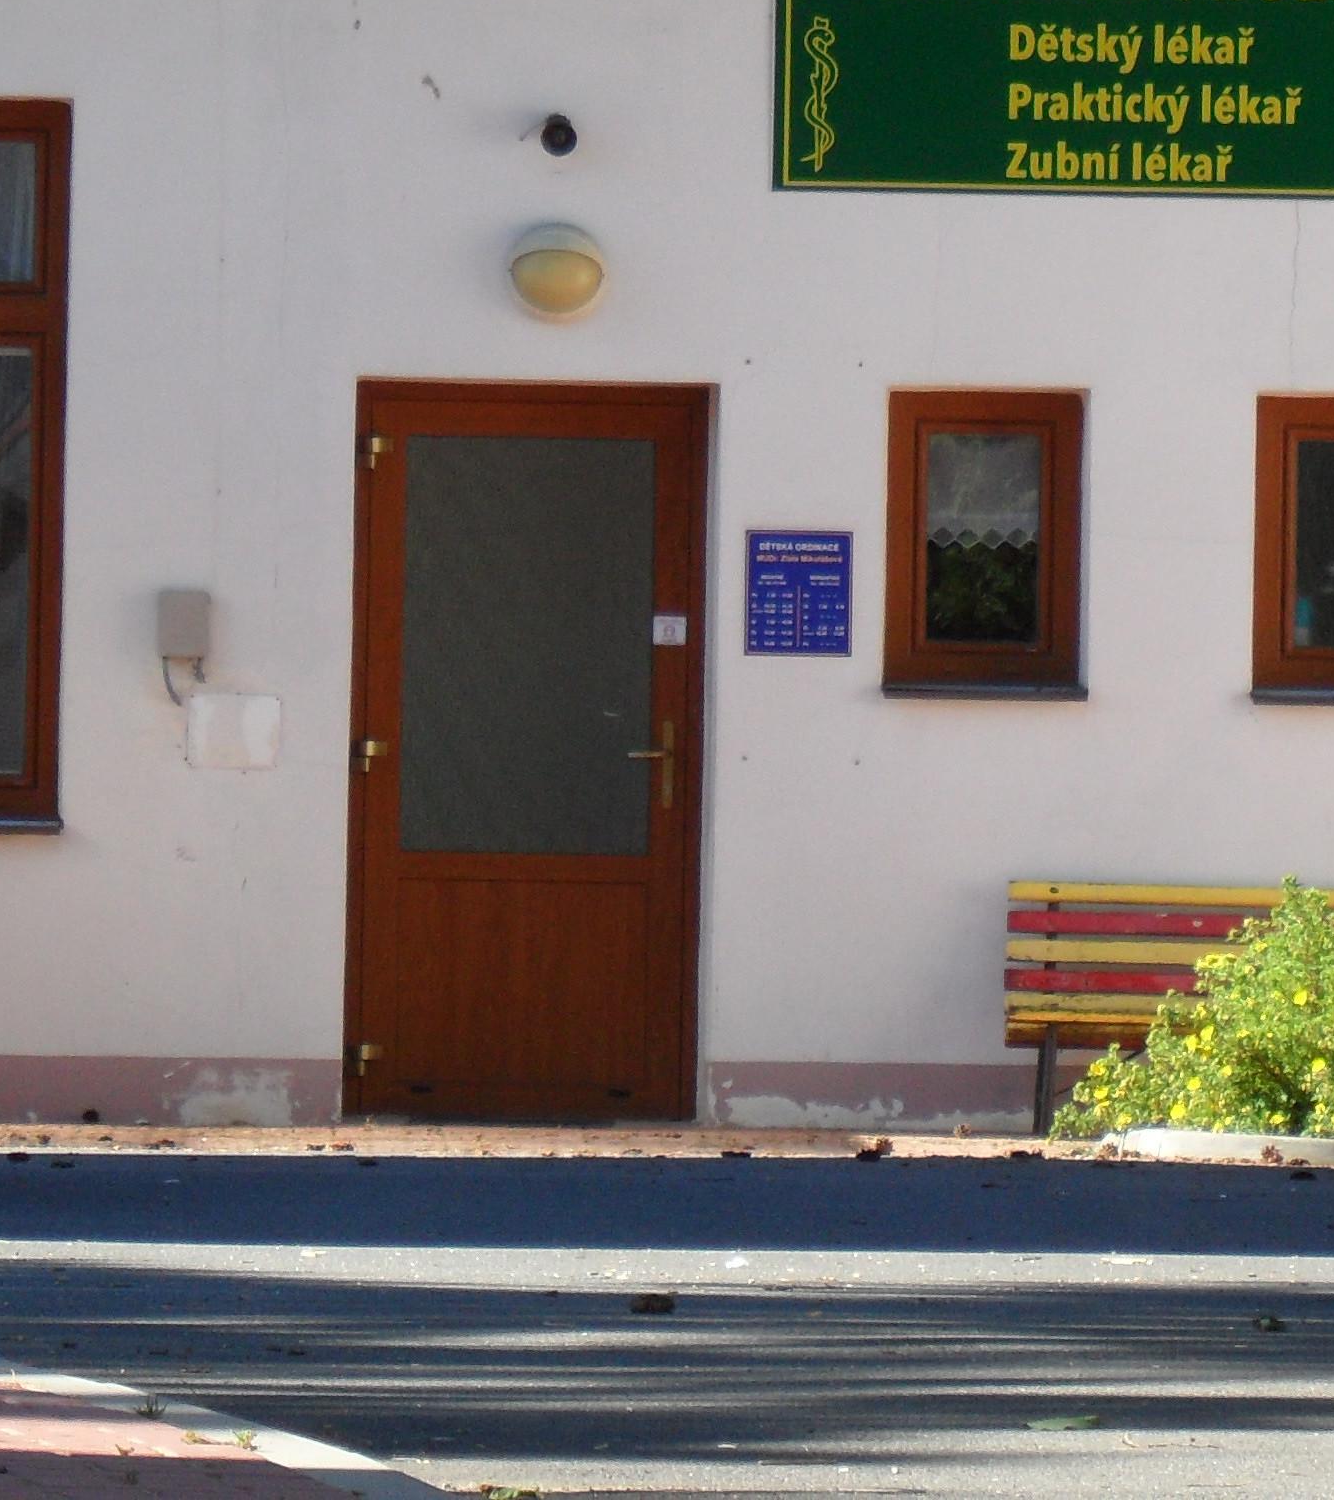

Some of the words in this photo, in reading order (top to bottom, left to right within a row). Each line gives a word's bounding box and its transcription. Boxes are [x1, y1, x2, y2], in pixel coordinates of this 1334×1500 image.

[1009, 23, 1142, 74] Dětský
[1154, 24, 1255, 65] lékař
[1007, 83, 1190, 134] Praktický
[1201, 84, 1302, 125] lékař
[1005, 141, 1119, 181] Zubní
[1131, 142, 1233, 183] lékař
